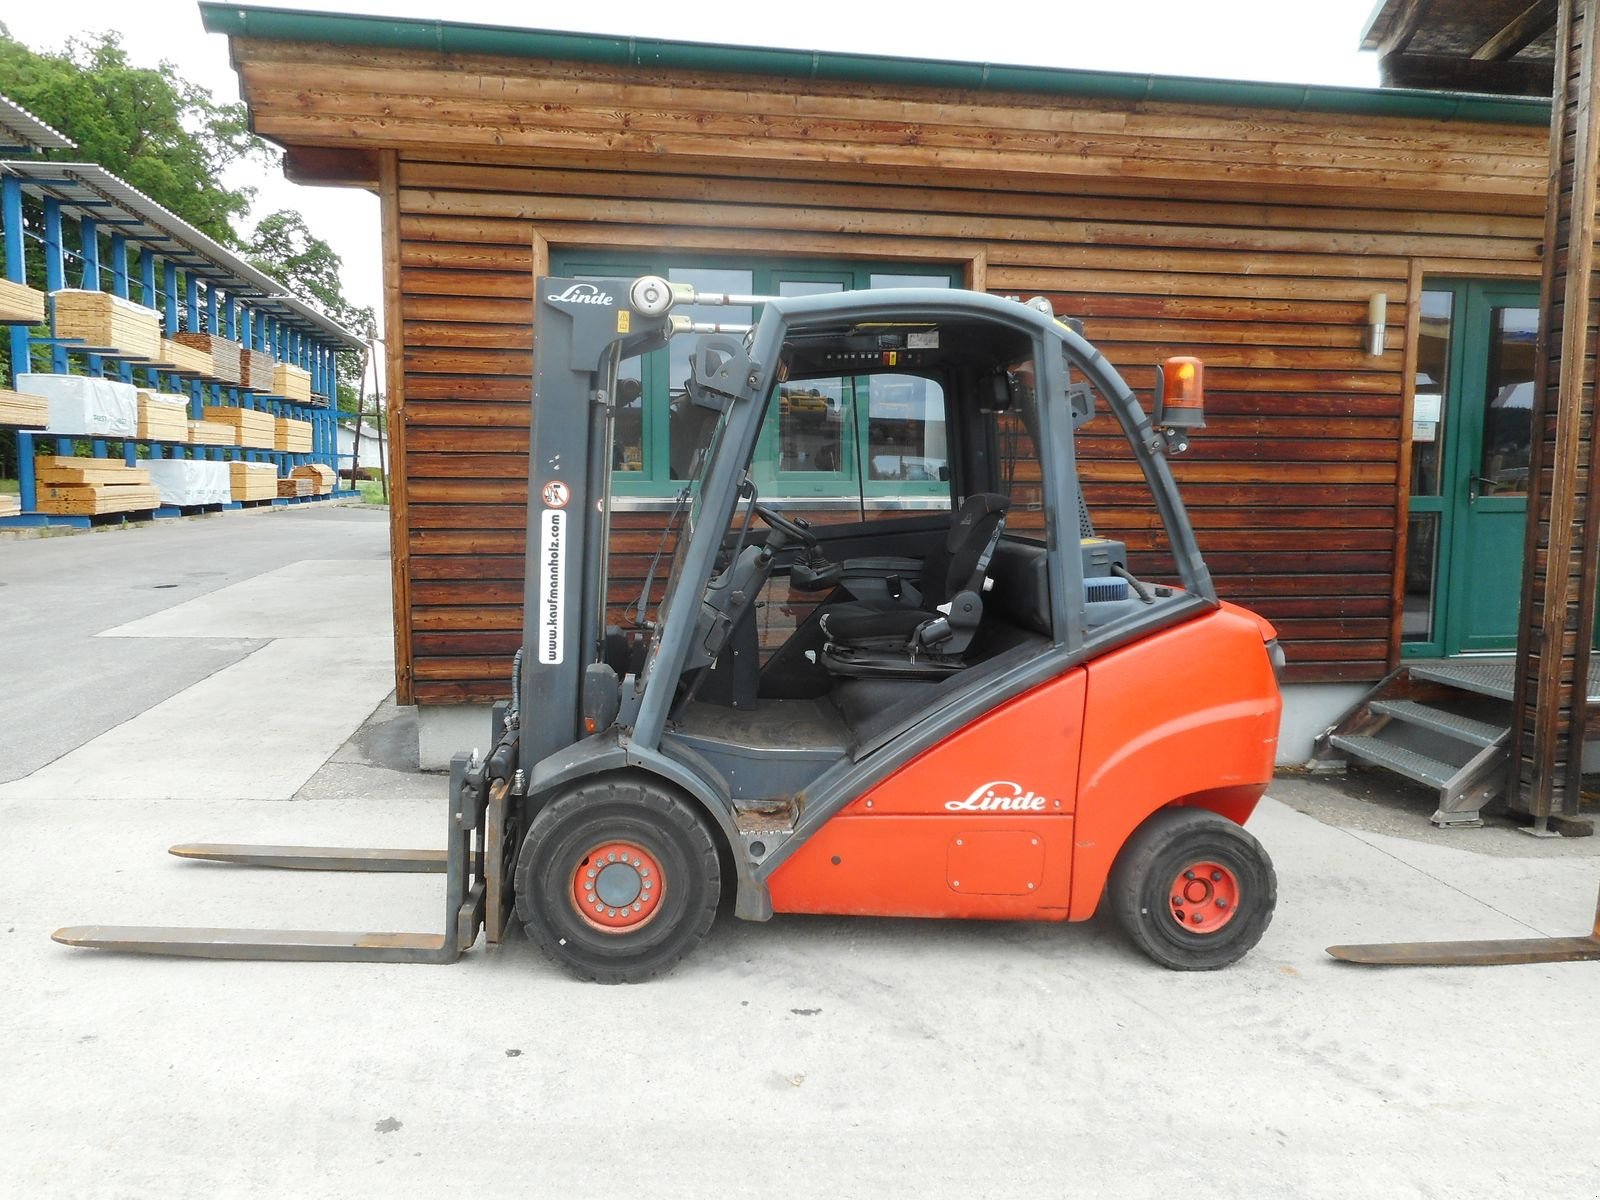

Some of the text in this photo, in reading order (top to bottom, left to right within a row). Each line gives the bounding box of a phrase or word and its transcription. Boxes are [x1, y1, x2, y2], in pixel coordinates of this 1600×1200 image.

[547, 283, 614, 306] Linde
[547, 514, 560, 661] www.kaufmannholz.com
[944, 780, 1046, 811] Linde
